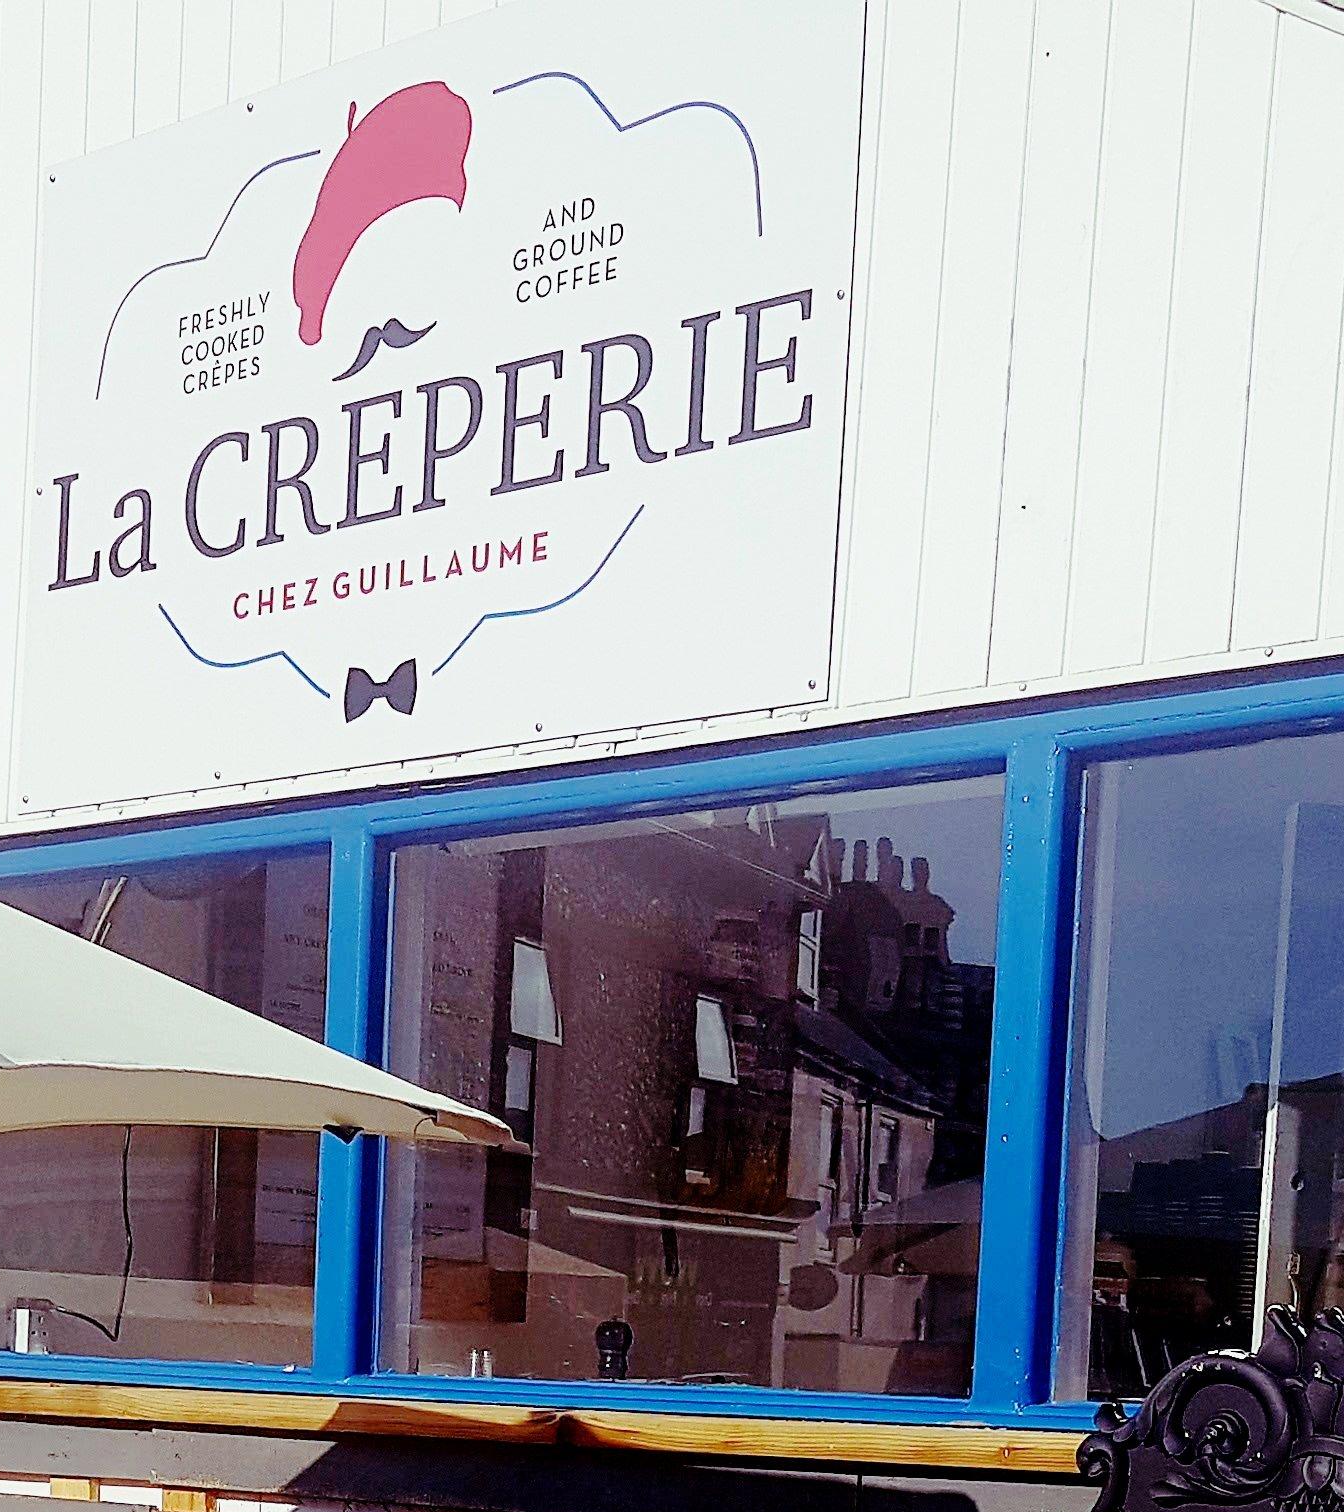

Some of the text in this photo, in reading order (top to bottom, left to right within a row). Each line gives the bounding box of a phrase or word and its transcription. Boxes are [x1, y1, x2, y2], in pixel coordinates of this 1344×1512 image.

[543, 198, 595, 232] AND
[513, 223, 623, 271] GROUND
[517, 257, 617, 303] COFFEE
[179, 291, 270, 338] FRESHLY
[182, 325, 264, 365] COOKED
[184, 357, 259, 394] CRÊPES
[48, 473, 157, 591] La
[234, 531, 548, 619] CHEZ GUILLAUME
